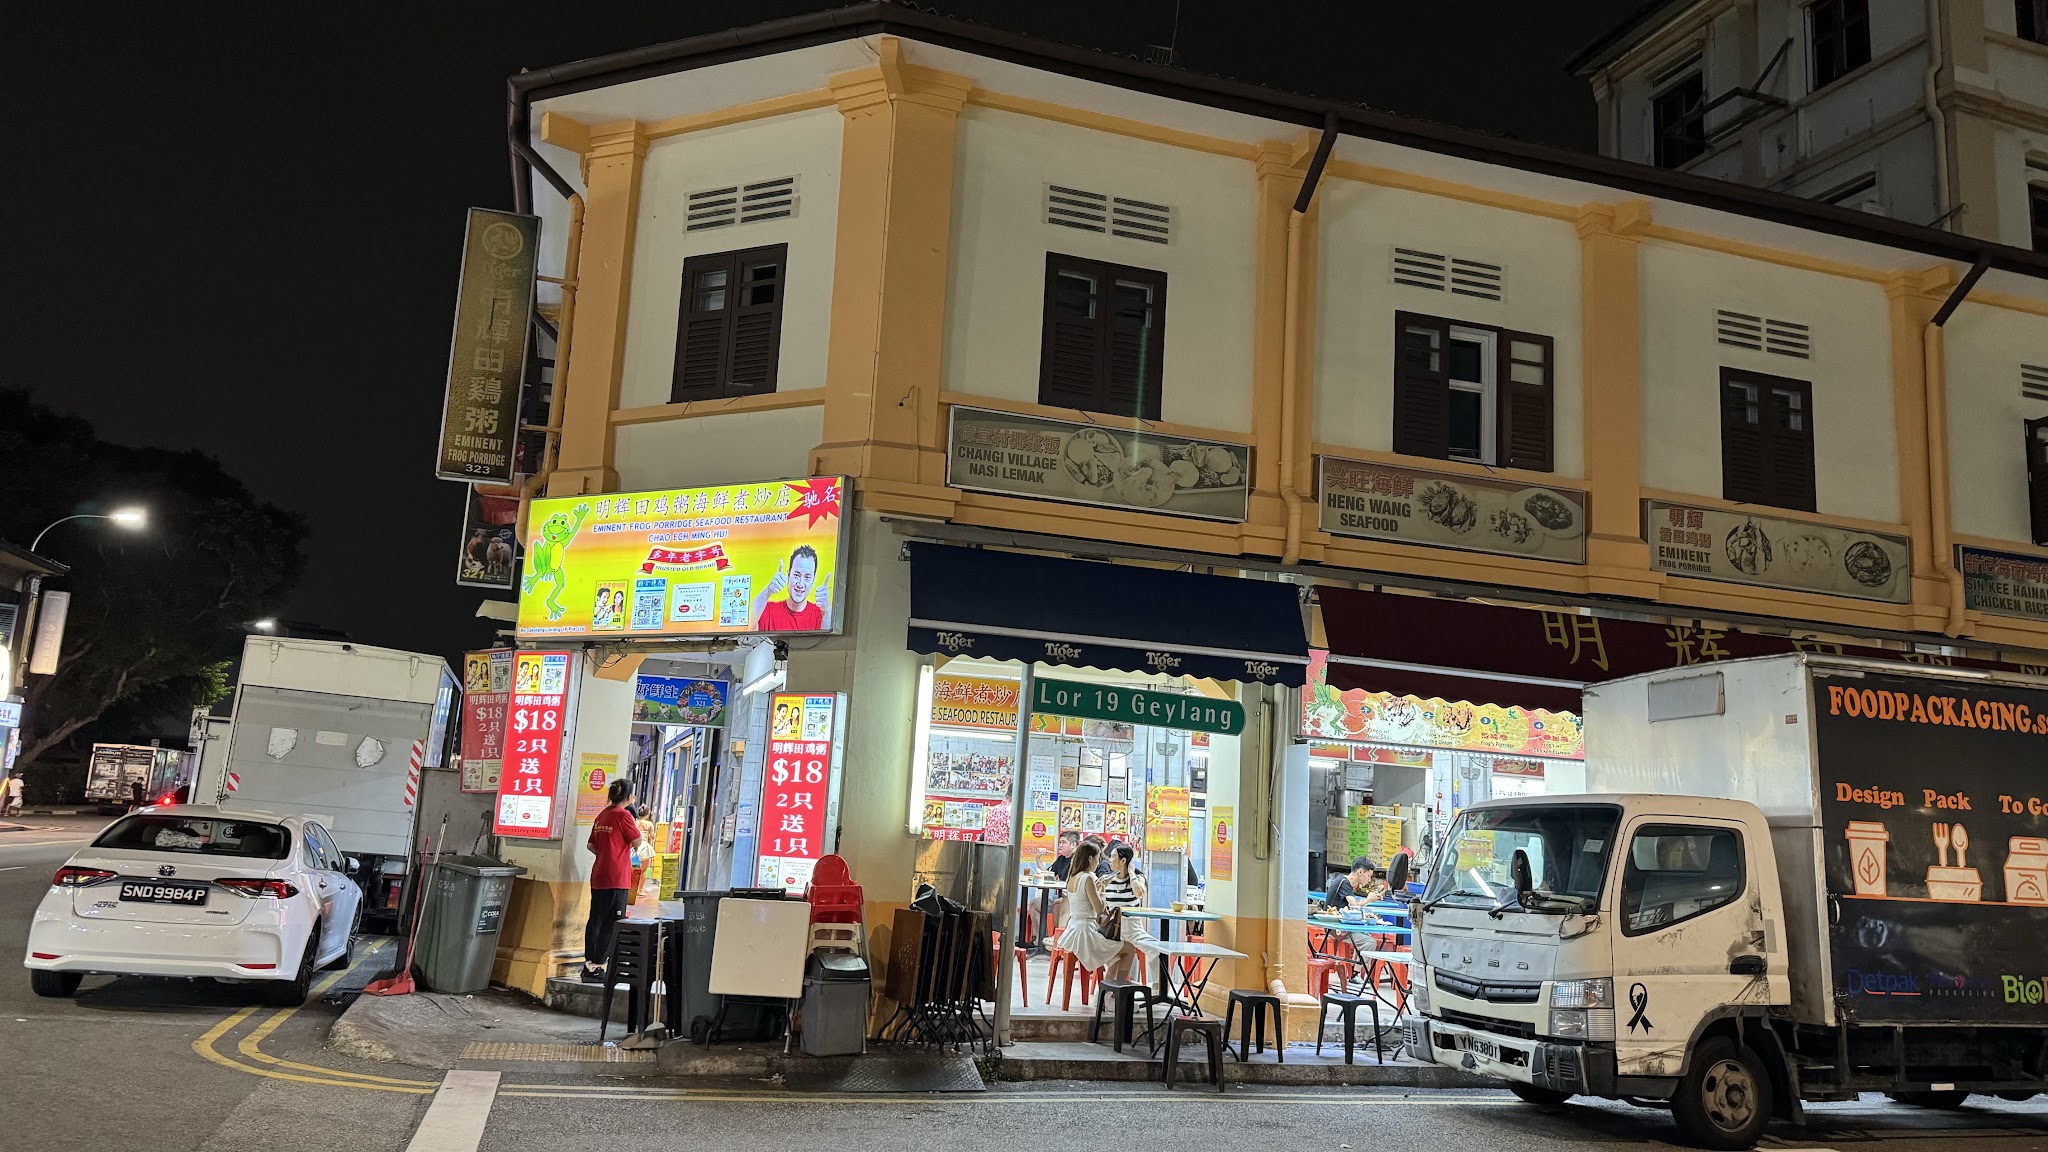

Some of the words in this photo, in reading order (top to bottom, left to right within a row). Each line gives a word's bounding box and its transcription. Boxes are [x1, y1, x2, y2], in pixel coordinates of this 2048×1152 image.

[455, 434, 503, 451] EMINENT
[448, 449, 467, 462] FROG
[469, 450, 505, 467] PORRIDGE
[958, 446, 1004, 464] CHANGI
[1008, 452, 1057, 470] VILLAGE
[465, 464, 491, 474] 323
[969, 462, 998, 477] NASI
[1002, 467, 1045, 483] LEMAK
[1327, 465, 1414, 499] 兴旺海鲜
[803, 486, 836, 508] 驰名
[1327, 493, 1365, 512] HENG
[1369, 499, 1411, 517] WANG
[593, 523, 626, 532] EMINENT
[630, 522, 651, 531] FROG
[654, 520, 693, 529] PORRIDGE
[695, 516, 731, 526] SEAFOOD
[735, 513, 788, 524] RESTAURANT
[1340, 513, 1399, 532] SEAFOOD
[1669, 508, 1704, 530] 明辉
[648, 533, 670, 542] CHAO
[691, 531, 711, 540] MING
[1659, 546, 1711, 563] EMINENT
[462, 568, 485, 580] 321
[1659, 560, 1676, 569] FROG
[1679, 562, 1712, 573] PORRIDGE
[1966, 576, 1984, 592] SIN
[1988, 581, 2009, 595] KEE
[2013, 584, 2048, 600] HAINA
[1974, 594, 2022, 611] CHICKEN
[936, 632, 975, 651] Tiger
[1045, 643, 1082, 661] Tiger
[1146, 652, 1182, 670] Tiger
[1245, 661, 1279, 679] Tiger
[476, 707, 503, 721] $18
[938, 707, 978, 723] SEAFOOD
[1040, 682, 1082, 707] Lor
[1095, 690, 1119, 711] 19
[1132, 694, 1232, 730] Geylang
[1828, 685, 2048, 735] FOODPACKAGING.s
[514, 708, 557, 733] $18
[483, 734, 496, 746] 送
[516, 738, 548, 754] 2只
[772, 742, 827, 755] 明辉田鸡粥
[519, 758, 540, 774] 送
[771, 758, 823, 786] $18
[513, 778, 543, 794] 1只
[776, 792, 813, 810] 2只
[1835, 783, 1905, 808] Design
[1923, 789, 1972, 811] Pack
[1998, 795, 2024, 814] To
[780, 814, 805, 833] 送
[773, 837, 809, 856] 1只
[1847, 968, 1919, 993] Detpak
